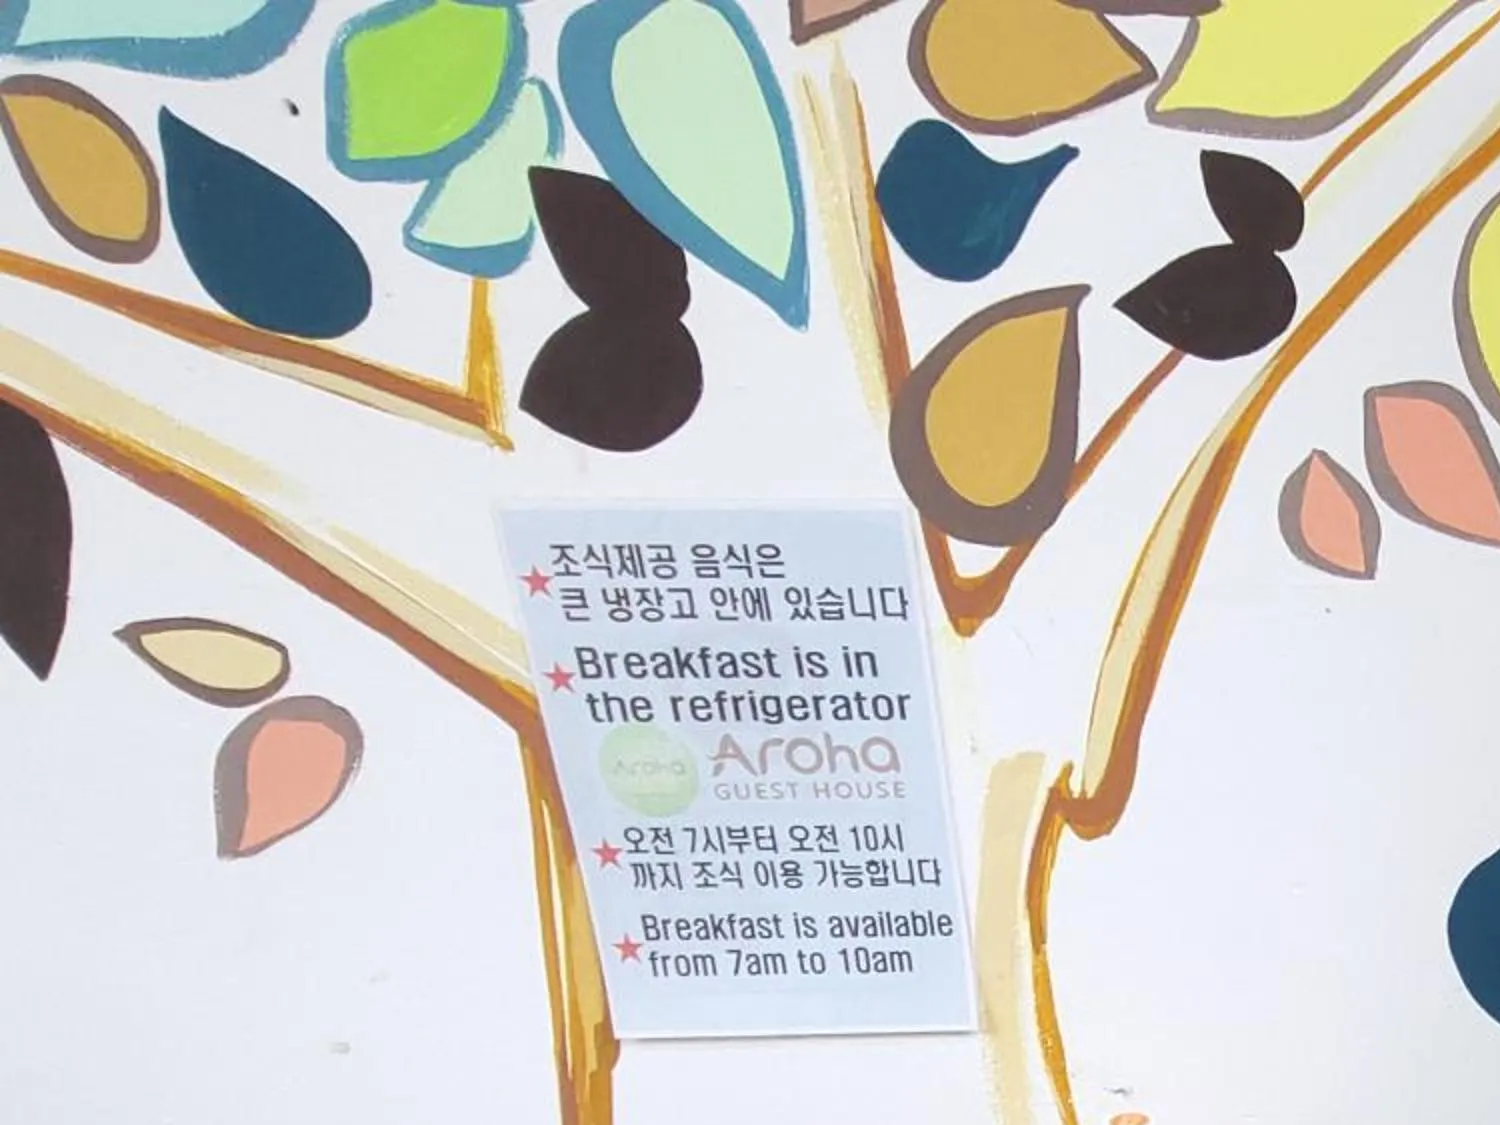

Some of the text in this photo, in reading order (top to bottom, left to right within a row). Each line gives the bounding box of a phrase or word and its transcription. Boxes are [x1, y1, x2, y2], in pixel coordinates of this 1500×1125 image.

[549, 543, 786, 580] 조식제공 음식은
[559, 586, 909, 622] 큰 냉장고 안에 있습니다
[574, 645, 879, 680] Breakfast is in
[586, 690, 912, 725] the refrigerator
[707, 731, 902, 777] Aroha
[714, 780, 906, 801] GUEST HOUSE
[623, 824, 905, 856] 오전 7시부터 오전 10시
[631, 857, 942, 892] 까지 조식 이용 가능합니다
[640, 910, 954, 942] Breakfast is available
[648, 947, 914, 978] from 7am to 10am
